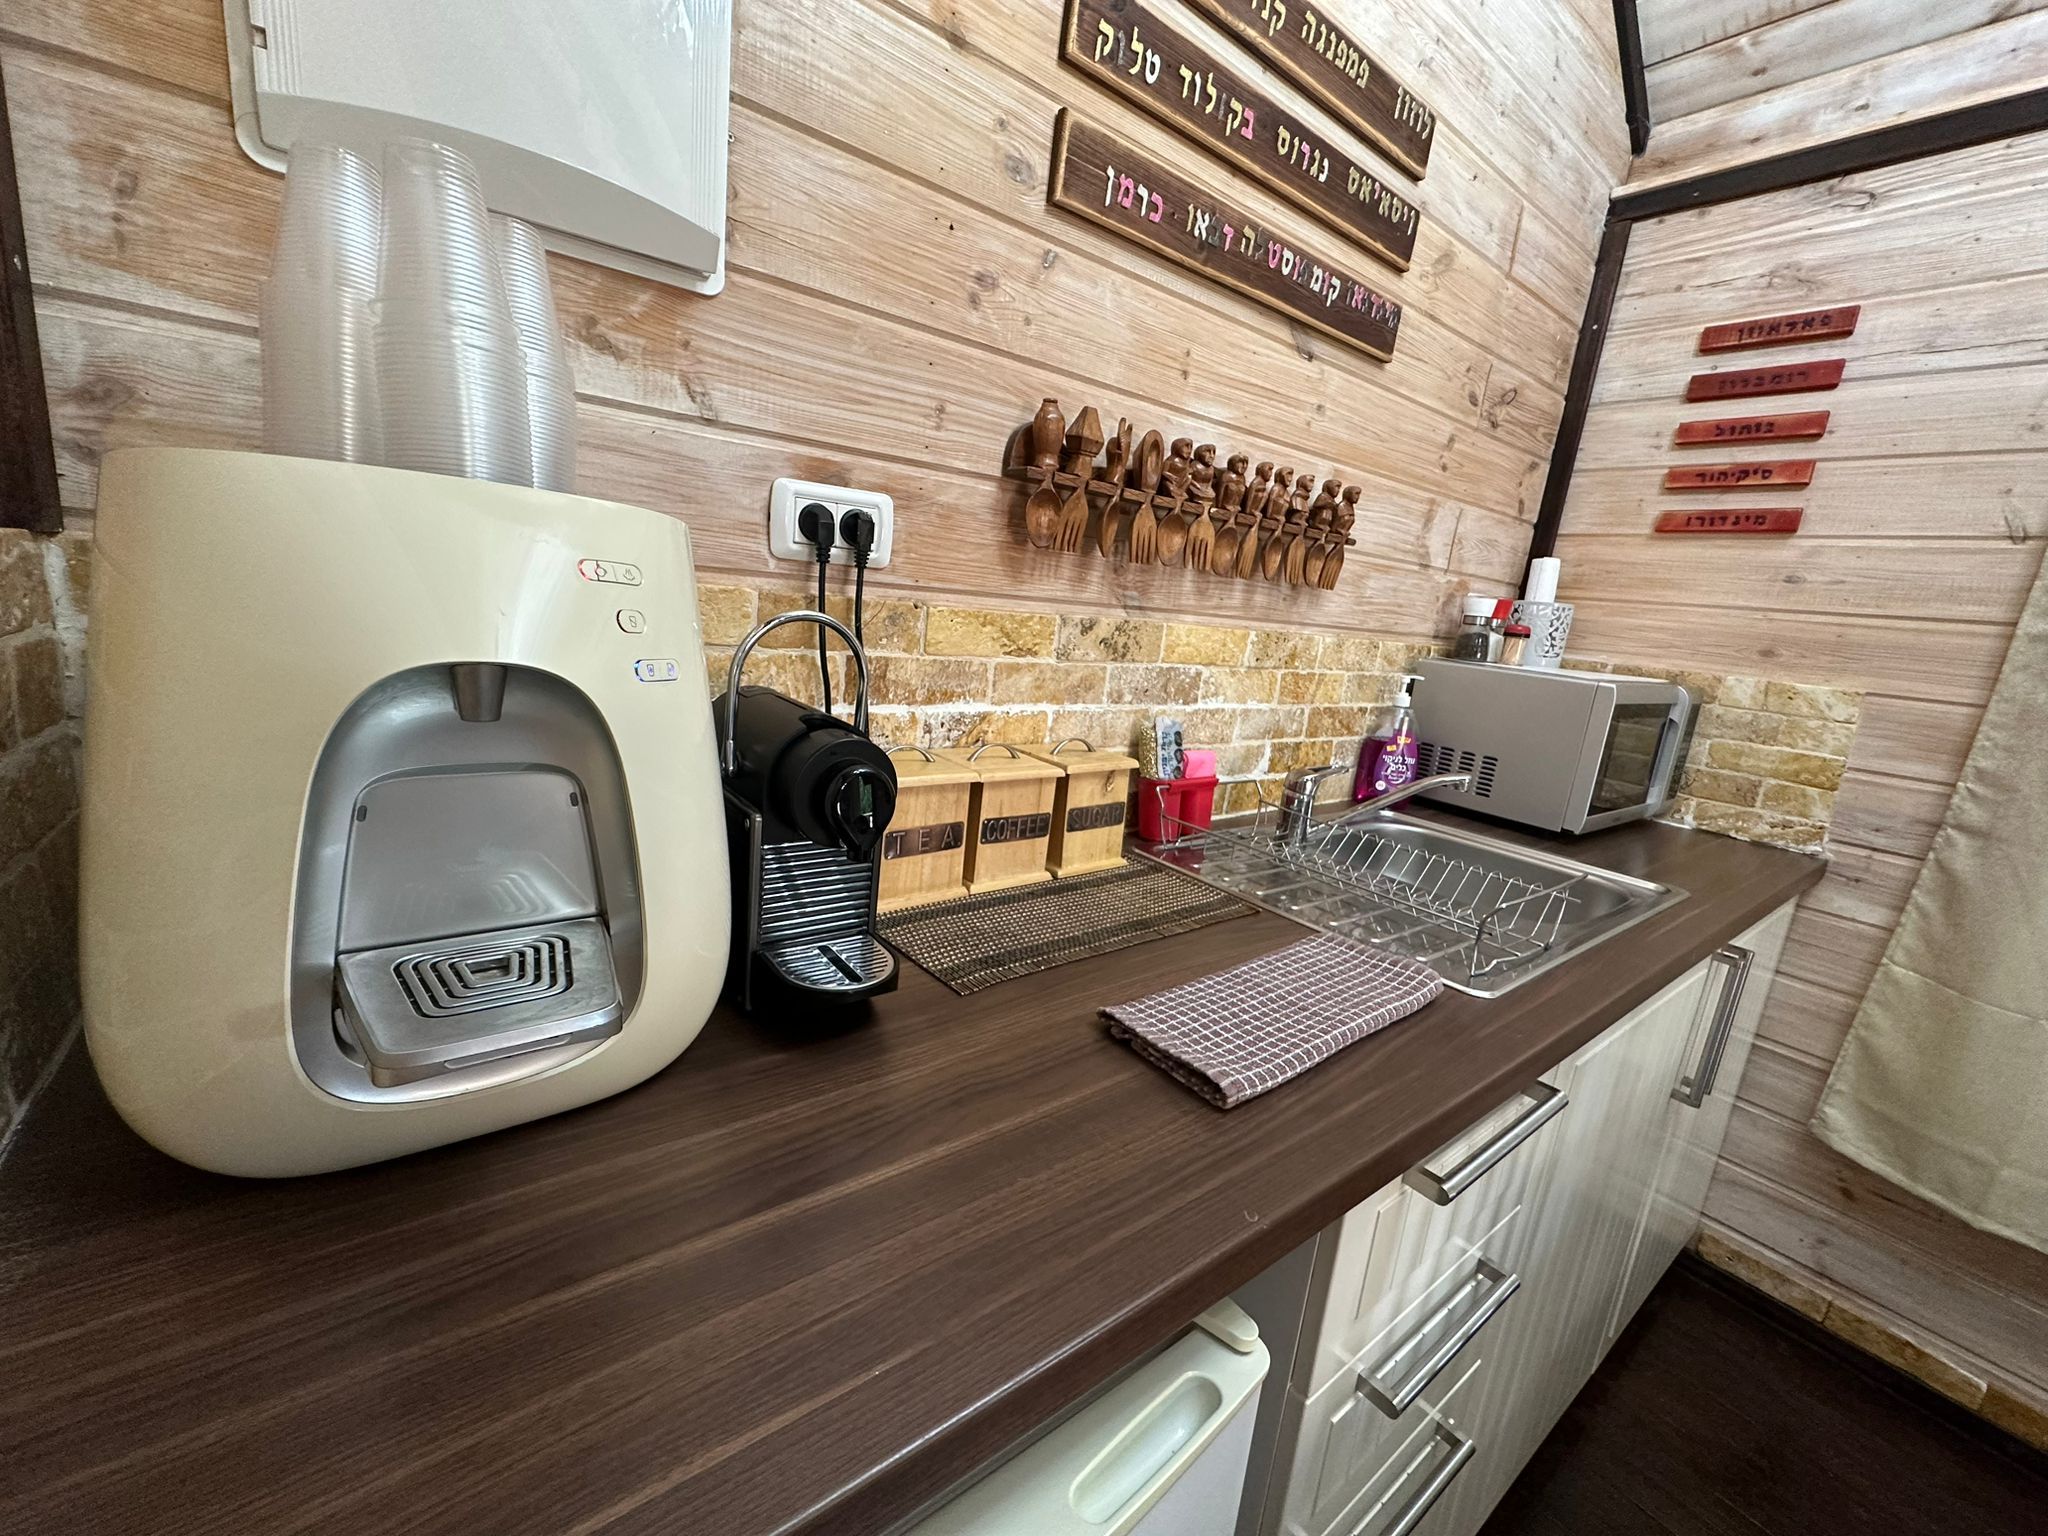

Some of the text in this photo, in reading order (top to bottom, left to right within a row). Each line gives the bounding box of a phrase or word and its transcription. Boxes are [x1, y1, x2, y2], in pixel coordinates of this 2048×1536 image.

[1252, 0, 1432, 139] לוזון פמפנגה קנ
[1104, 165, 1163, 223] כרמן
[986, 814, 1047, 840] COFFEE
[1070, 804, 1122, 828] SUGAR
